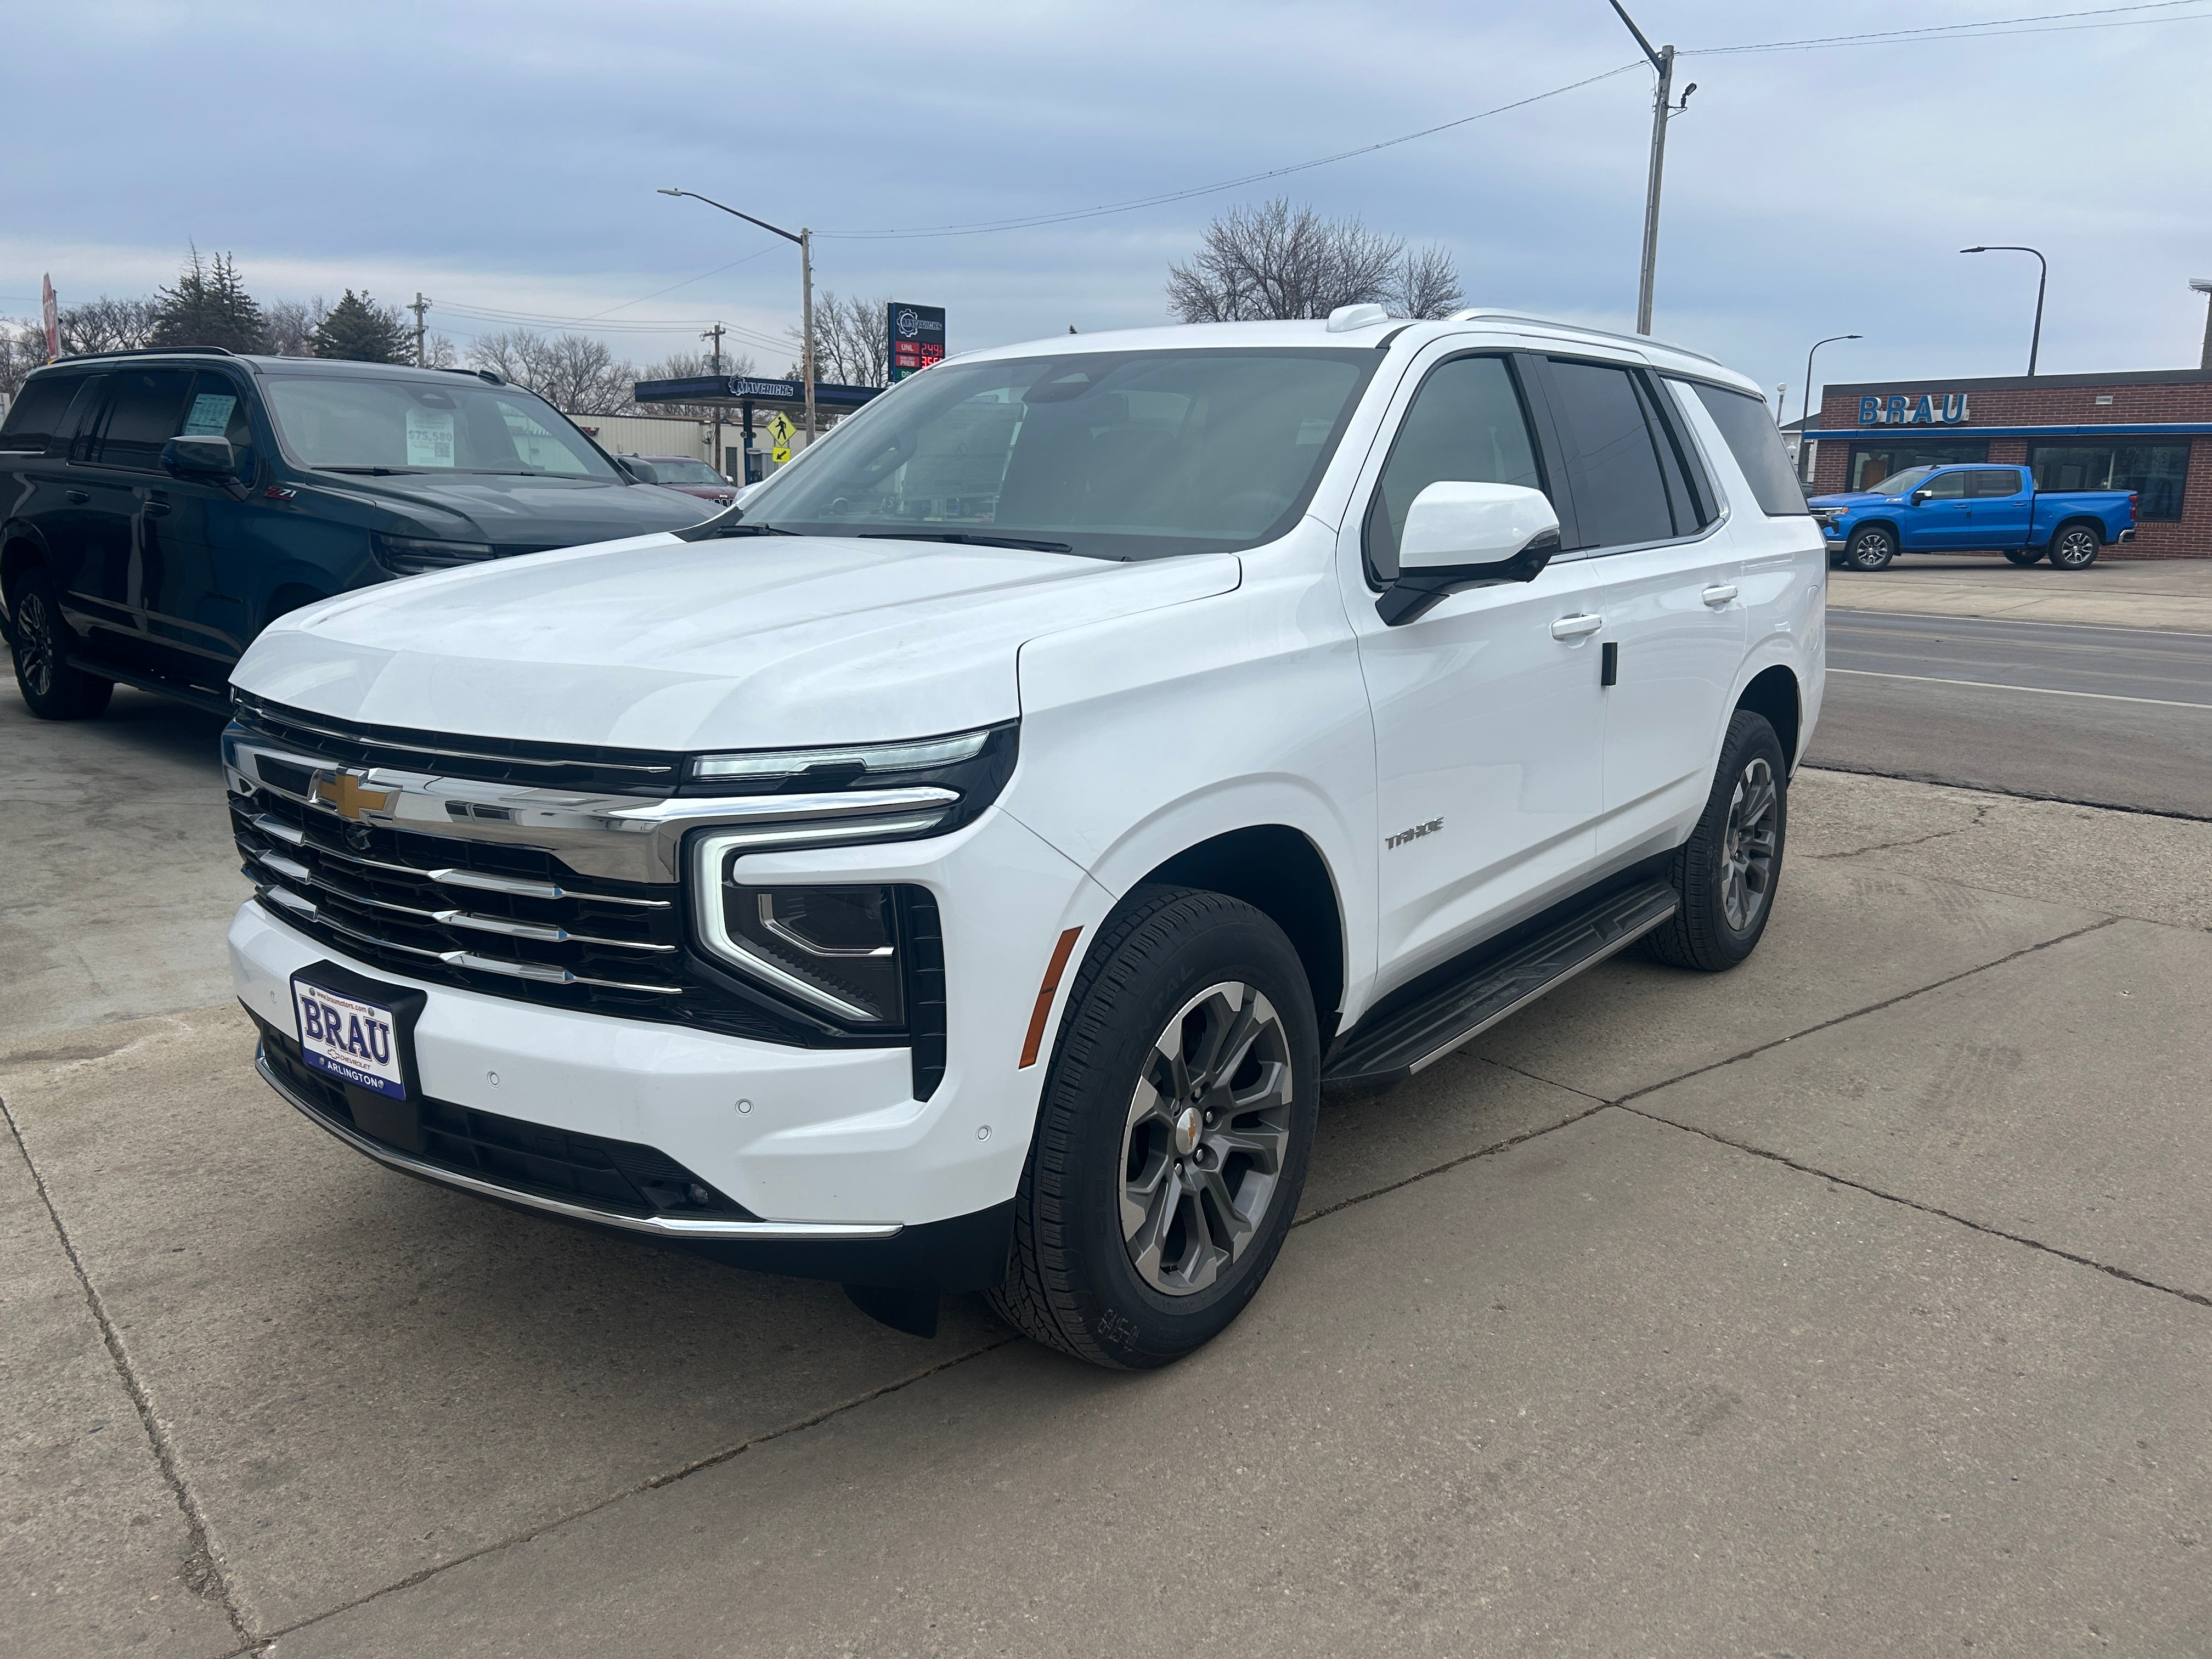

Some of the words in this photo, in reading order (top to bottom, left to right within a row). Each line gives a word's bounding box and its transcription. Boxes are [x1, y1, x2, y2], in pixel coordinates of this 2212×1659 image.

[1858, 394, 1968, 425] BRAU
[264, 486, 298, 500] Z71
[1385, 816, 1444, 850] TAHOE
[300, 994, 390, 1066] BRAU
[328, 1060, 379, 1088] ARLINGTON
[340, 1055, 371, 1070] CHEVROLET
